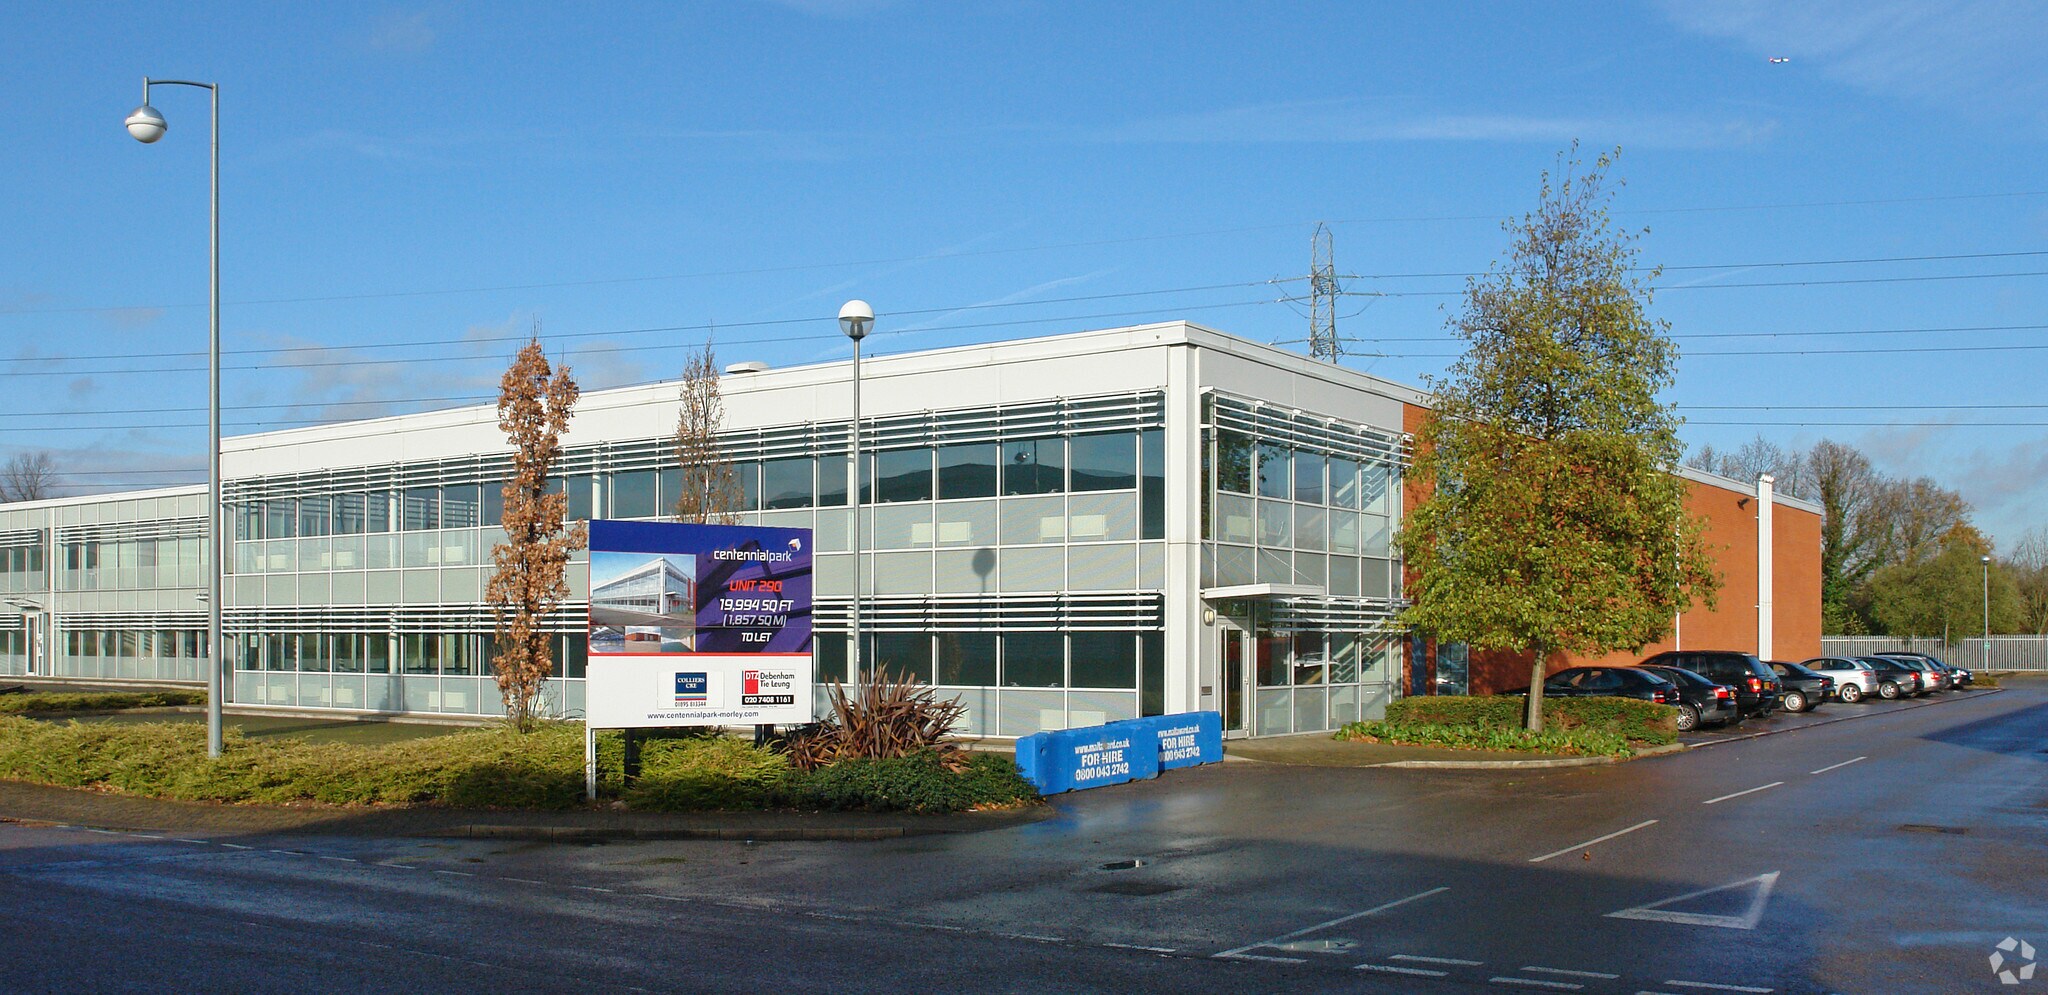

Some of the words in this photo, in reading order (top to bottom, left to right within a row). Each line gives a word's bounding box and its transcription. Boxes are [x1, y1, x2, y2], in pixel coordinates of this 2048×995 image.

[714, 549, 791, 563] centennialpark
[729, 580, 757, 592] UNIT
[758, 580, 783, 592] 290
[719, 599, 760, 612] 19,994
[761, 600, 778, 612] SQ
[779, 600, 794, 611] FT
[723, 614, 756, 627] (1,857
[757, 615, 773, 626] SQ
[772, 615, 787, 628] M)
[741, 632, 754, 642] TO
[754, 632, 772, 642] LET
[745, 672, 759, 680] DTZ
[760, 671, 795, 680] Debenham
[771, 680, 791, 689] Leung
[647, 711, 759, 719] www.centennialpark-morley.com
[1162, 737, 1177, 750] FOR
[1178, 735, 1195, 748] HIRE
[1081, 753, 1100, 767] FOR
[1101, 750, 1123, 764] HIRE
[1173, 748, 1186, 760] 043
[1186, 746, 1200, 758] 2742
[1075, 767, 1095, 780] 0800
[1095, 764, 1111, 778] 043
[1111, 762, 1129, 775] 2742
